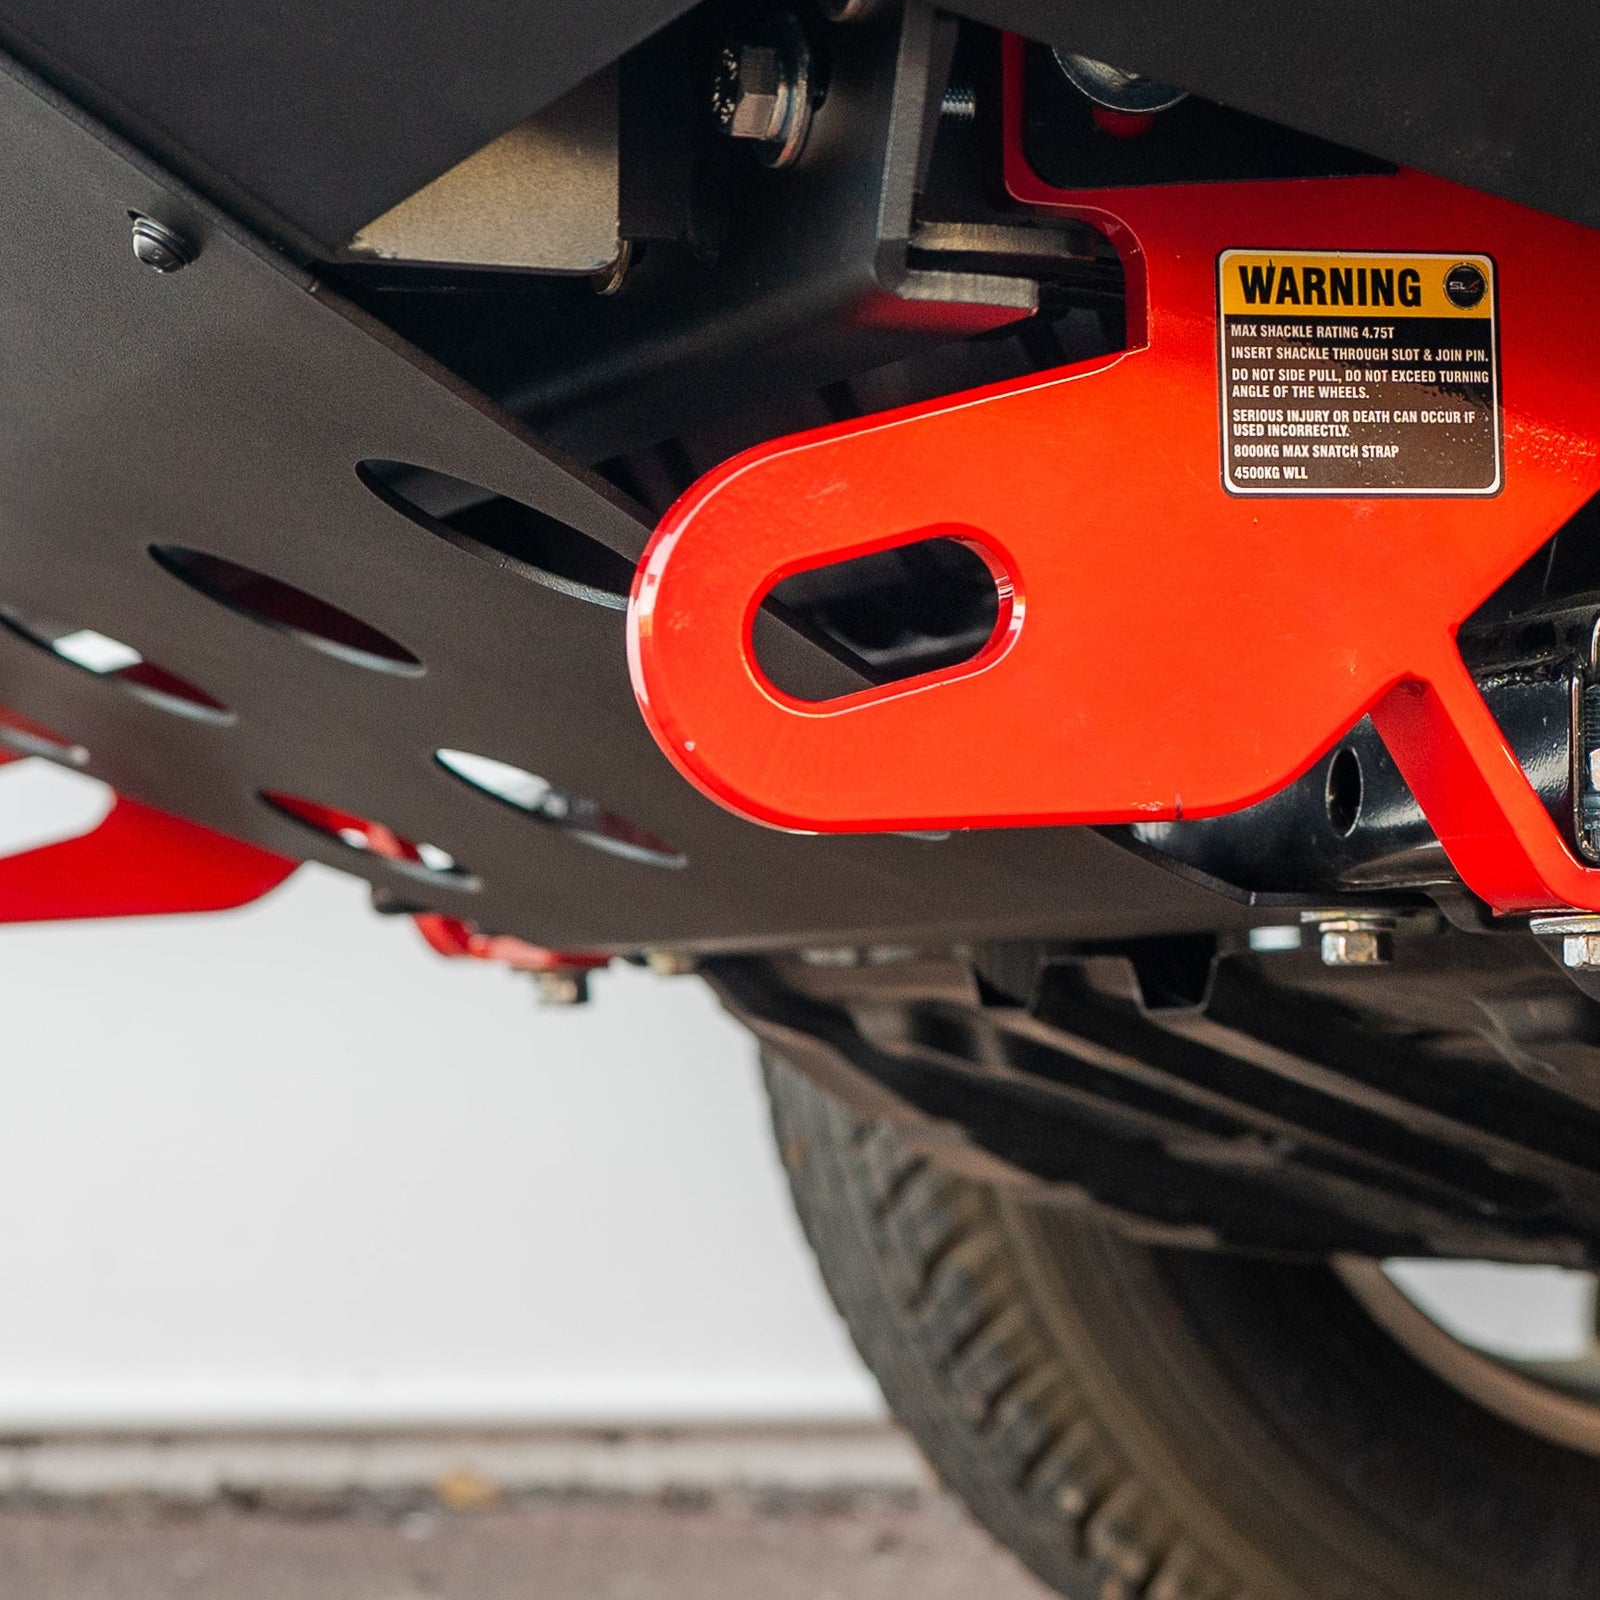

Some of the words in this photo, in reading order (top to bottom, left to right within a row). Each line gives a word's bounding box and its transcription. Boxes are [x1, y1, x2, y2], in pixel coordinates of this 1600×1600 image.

[1238, 265, 1422, 307] WARNING
[1231, 324, 1257, 337] MAX
[1260, 325, 1313, 338] SHACKLE
[1317, 325, 1359, 339] RATING
[1362, 326, 1395, 339] 4.75T
[1231, 347, 1273, 359] INSERT
[1276, 347, 1329, 360] SHACKLE
[1332, 348, 1388, 361] THROUGH
[1392, 349, 1420, 362] SLOT
[1423, 349, 1432, 362] &
[1435, 349, 1462, 362] JOIN
[1465, 350, 1489, 362] PIN.
[1232, 368, 1249, 381] DO
[1252, 369, 1275, 382] NOT
[1278, 369, 1305, 382] SIDE
[1309, 369, 1342, 385] PULL,
[1345, 370, 1361, 383] DO
[1365, 370, 1388, 383] NOT
[1391, 370, 1436, 383] EXCEED
[1439, 371, 1489, 384] TURNING
[1232, 385, 1270, 398] ANGLE
[1273, 386, 1289, 398] OF
[1292, 386, 1315, 398] THE
[1318, 386, 1370, 399] WHEELS.
[1233, 409, 1283, 422] SERIOUS
[1287, 410, 1330, 423] INJURY
[1333, 410, 1349, 423] OR
[1353, 410, 1389, 423] DEATH
[1393, 411, 1417, 423] CAN
[1421, 411, 1461, 424] OCCUR
[1464, 412, 1475, 424] IF
[1233, 424, 1264, 437] USED
[1267, 424, 1350, 438] INCORRECTLY.
[1234, 445, 1279, 458] 8000KG
[1282, 445, 1309, 458] MAX
[1312, 445, 1358, 458] SNATCH
[1362, 446, 1399, 459] STRAP
[1234, 466, 1280, 479] 4500KG
[1283, 467, 1308, 480] WLL
